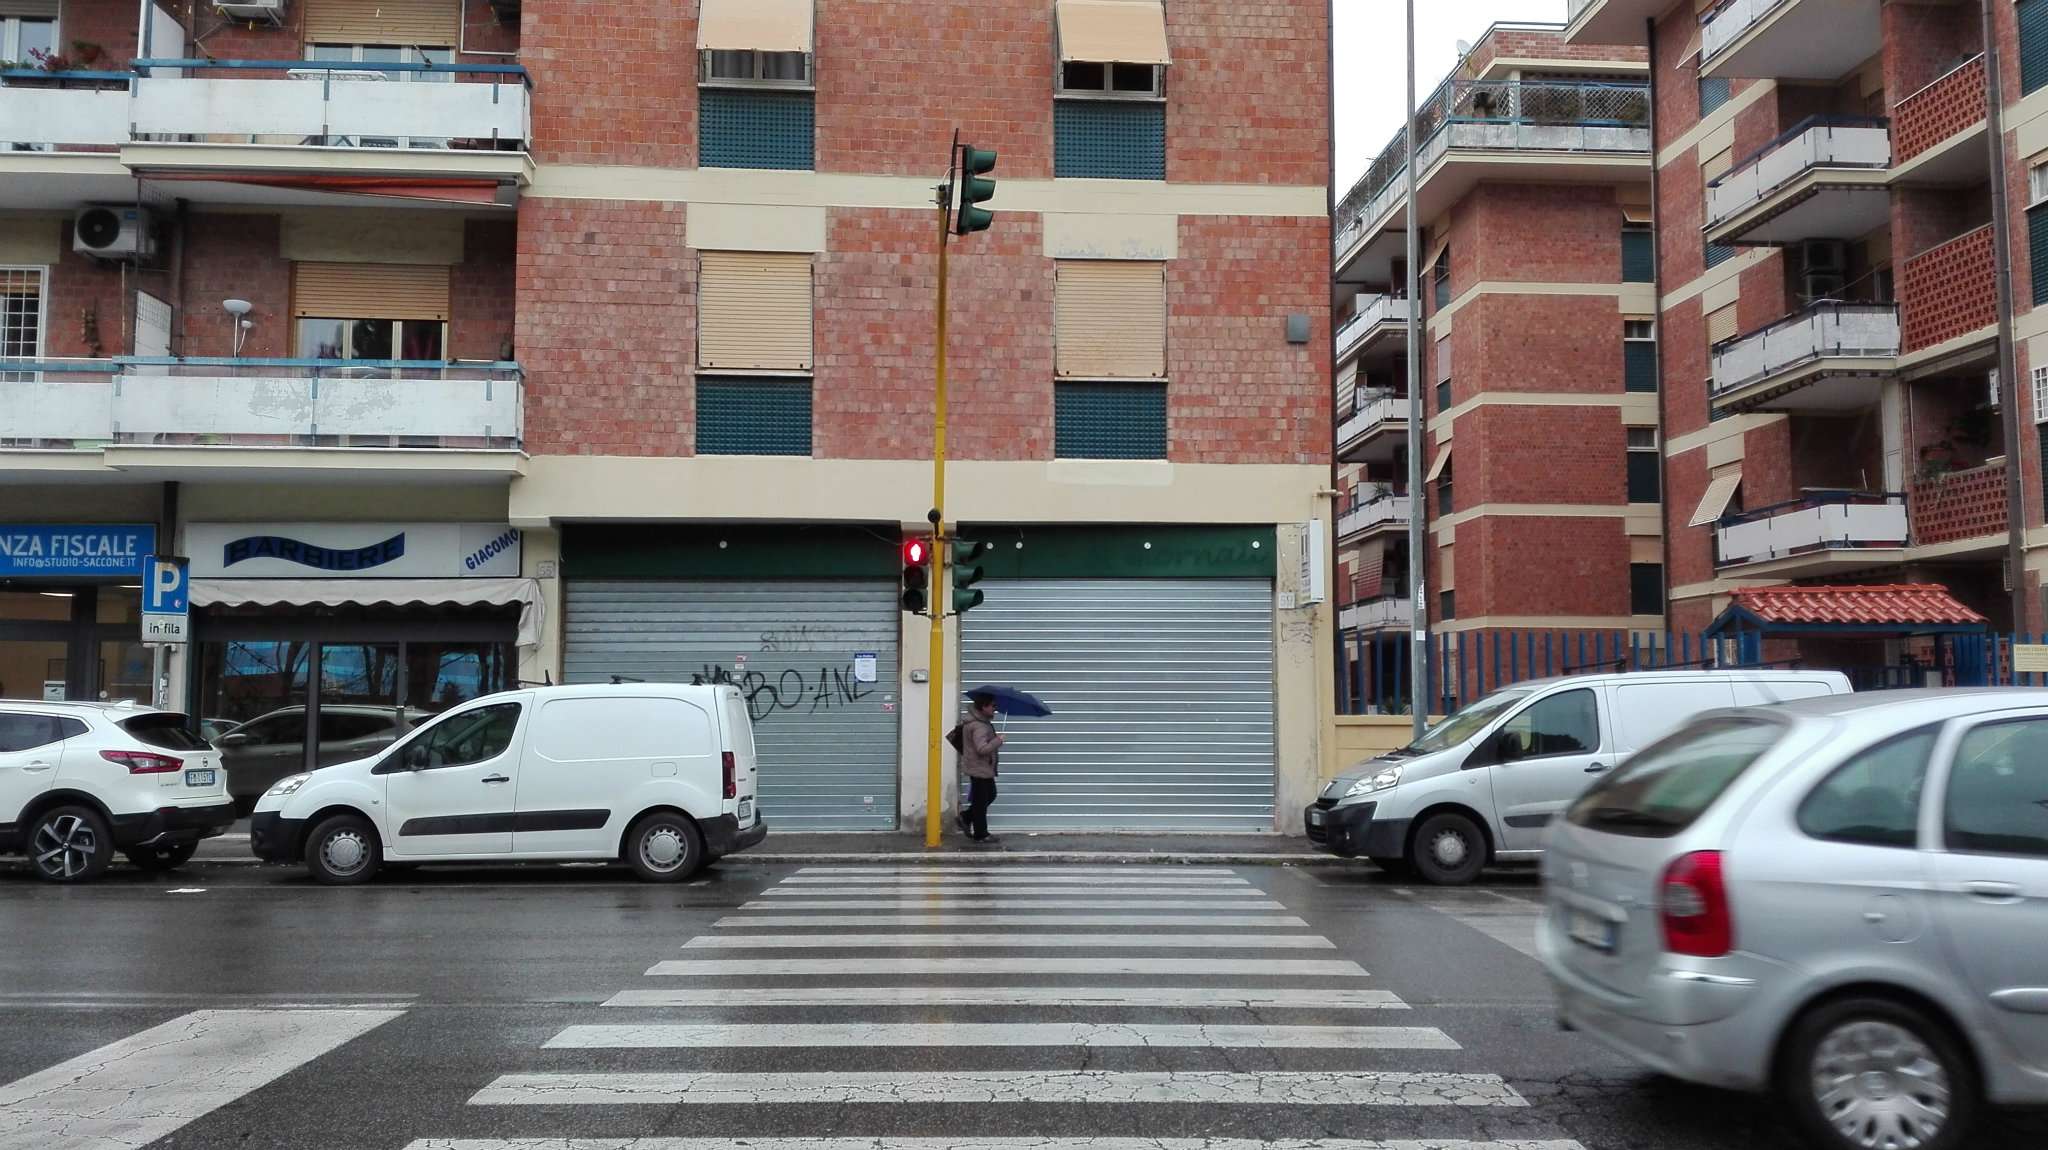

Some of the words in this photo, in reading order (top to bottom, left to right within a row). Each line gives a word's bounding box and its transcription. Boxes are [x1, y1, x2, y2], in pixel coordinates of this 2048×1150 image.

[51, 535, 137, 556] FISCALE
[229, 535, 402, 570] BARBIERE
[465, 528, 519, 570] GIACOMO
[13, 557, 136, 568] INFO@STUDIO-SACCONE.IT
[153, 561, 181, 607] P
[149, 622, 161, 634] in
[163, 622, 181, 634] fila
